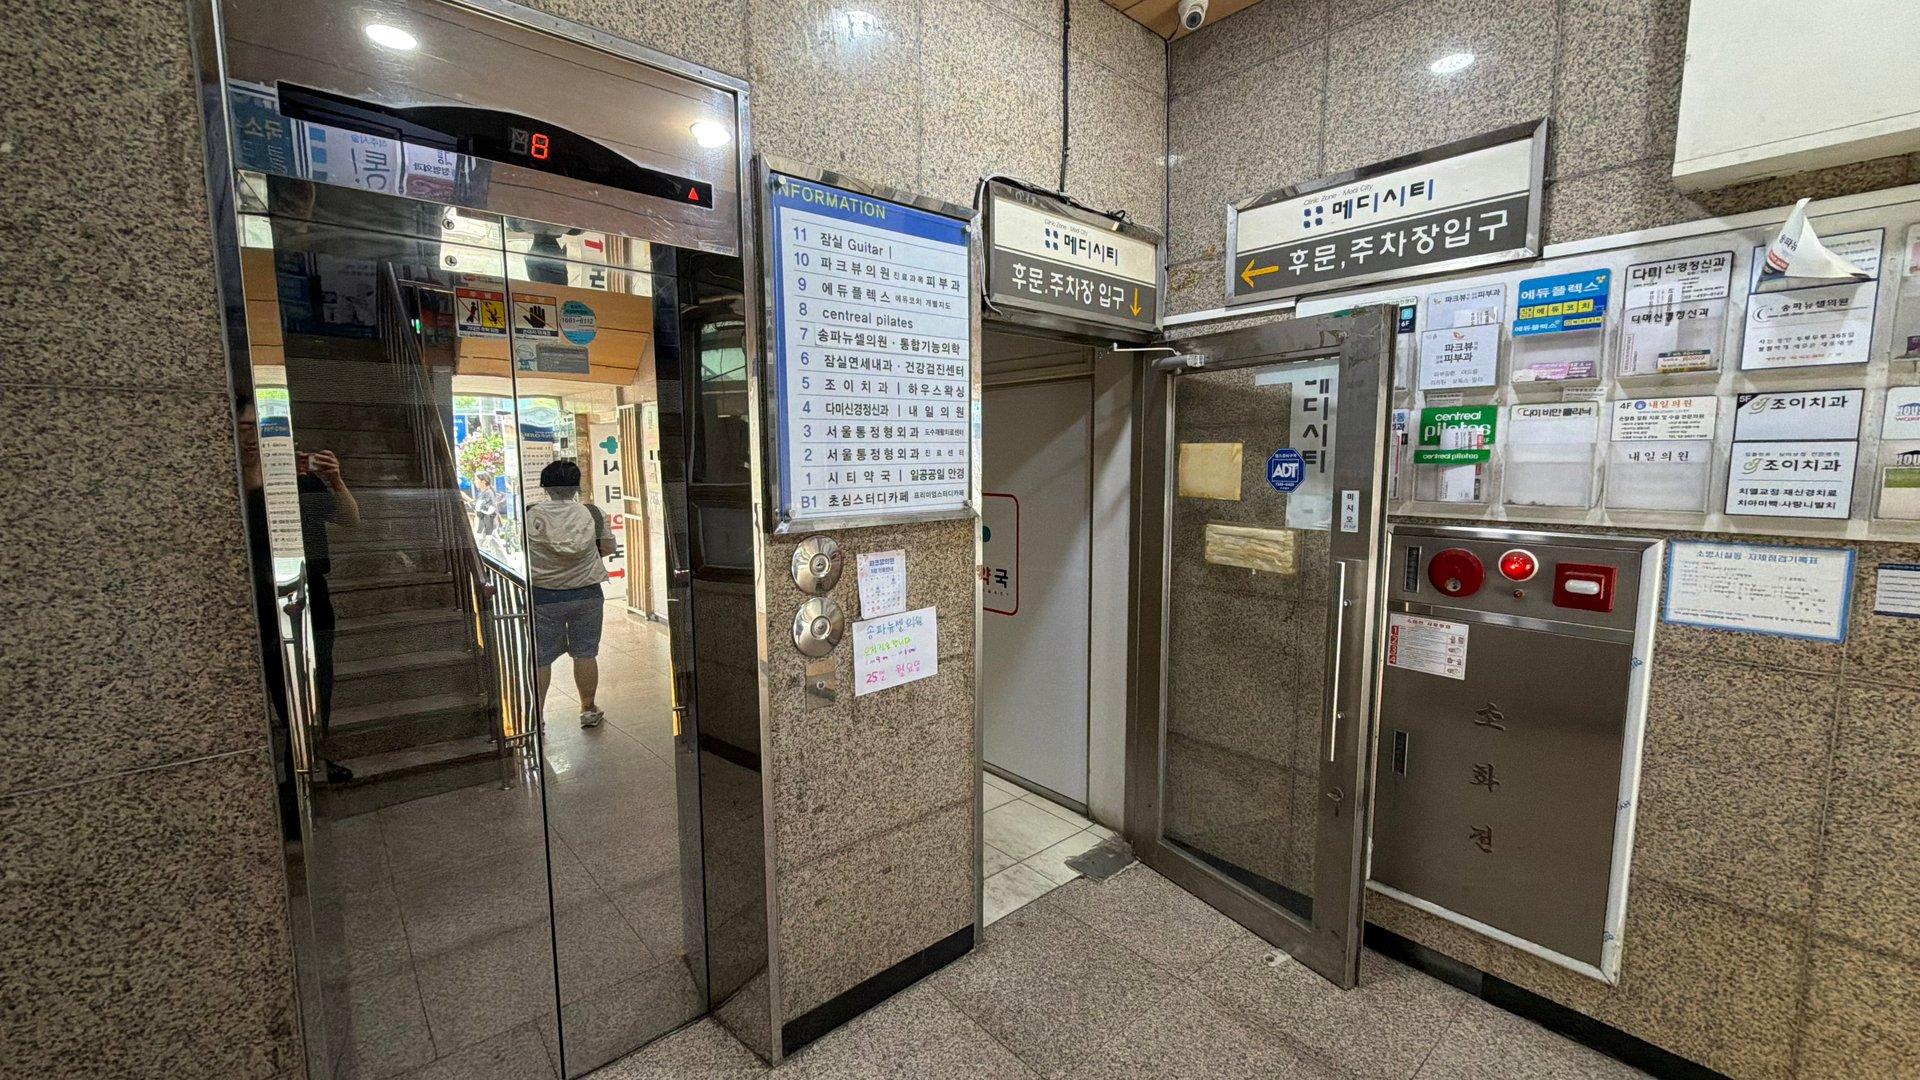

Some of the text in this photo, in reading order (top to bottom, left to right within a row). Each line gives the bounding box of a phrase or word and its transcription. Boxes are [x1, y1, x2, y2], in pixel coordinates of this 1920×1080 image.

[532, 134, 549, 160] 8
[777, 181, 887, 220] NFORMATION
[1332, 179, 1435, 220] 메디시티
[793, 227, 884, 256] 11 잠실 Guitar
[1063, 233, 1118, 266] 메디시티
[794, 252, 810, 267] 10
[926, 275, 961, 292] 피부과
[1632, 257, 1725, 280] 다미 신경정신과
[797, 277, 807, 291] 9
[821, 281, 891, 303] 에듀플렉스
[1099, 282, 1124, 310] 입구
[1521, 282, 1599, 300] 에듀플렉스
[799, 302, 914, 329] 8 centreal pilates
[1401, 320, 1410, 328] 6F
[800, 328, 808, 340] 7
[900, 337, 961, 356] 통합기능의학
[801, 352, 965, 378] 6 잠실연세내과 건강검진센터
[802, 376, 965, 398] 5 조이치과 하우스왁싱
[802, 401, 811, 414] 4
[825, 402, 889, 417] 다미신경정신과
[1770, 395, 1848, 410] 조이치과
[803, 425, 812, 438] 3
[826, 425, 919, 439] 서울통정형외과
[804, 449, 812, 462] 2
[827, 448, 919, 462] 서울통정형외과
[1762, 459, 1841, 471] 조이치과
[806, 467, 965, 485] 1 시티약국 일공공일 안경
[1272, 463, 1300, 478] ADT
[801, 496, 817, 508] B1
[828, 491, 909, 508] 초심스터디카페
[1346, 493, 1354, 523] 미시오
[1470, 702, 1506, 853] 소화전
